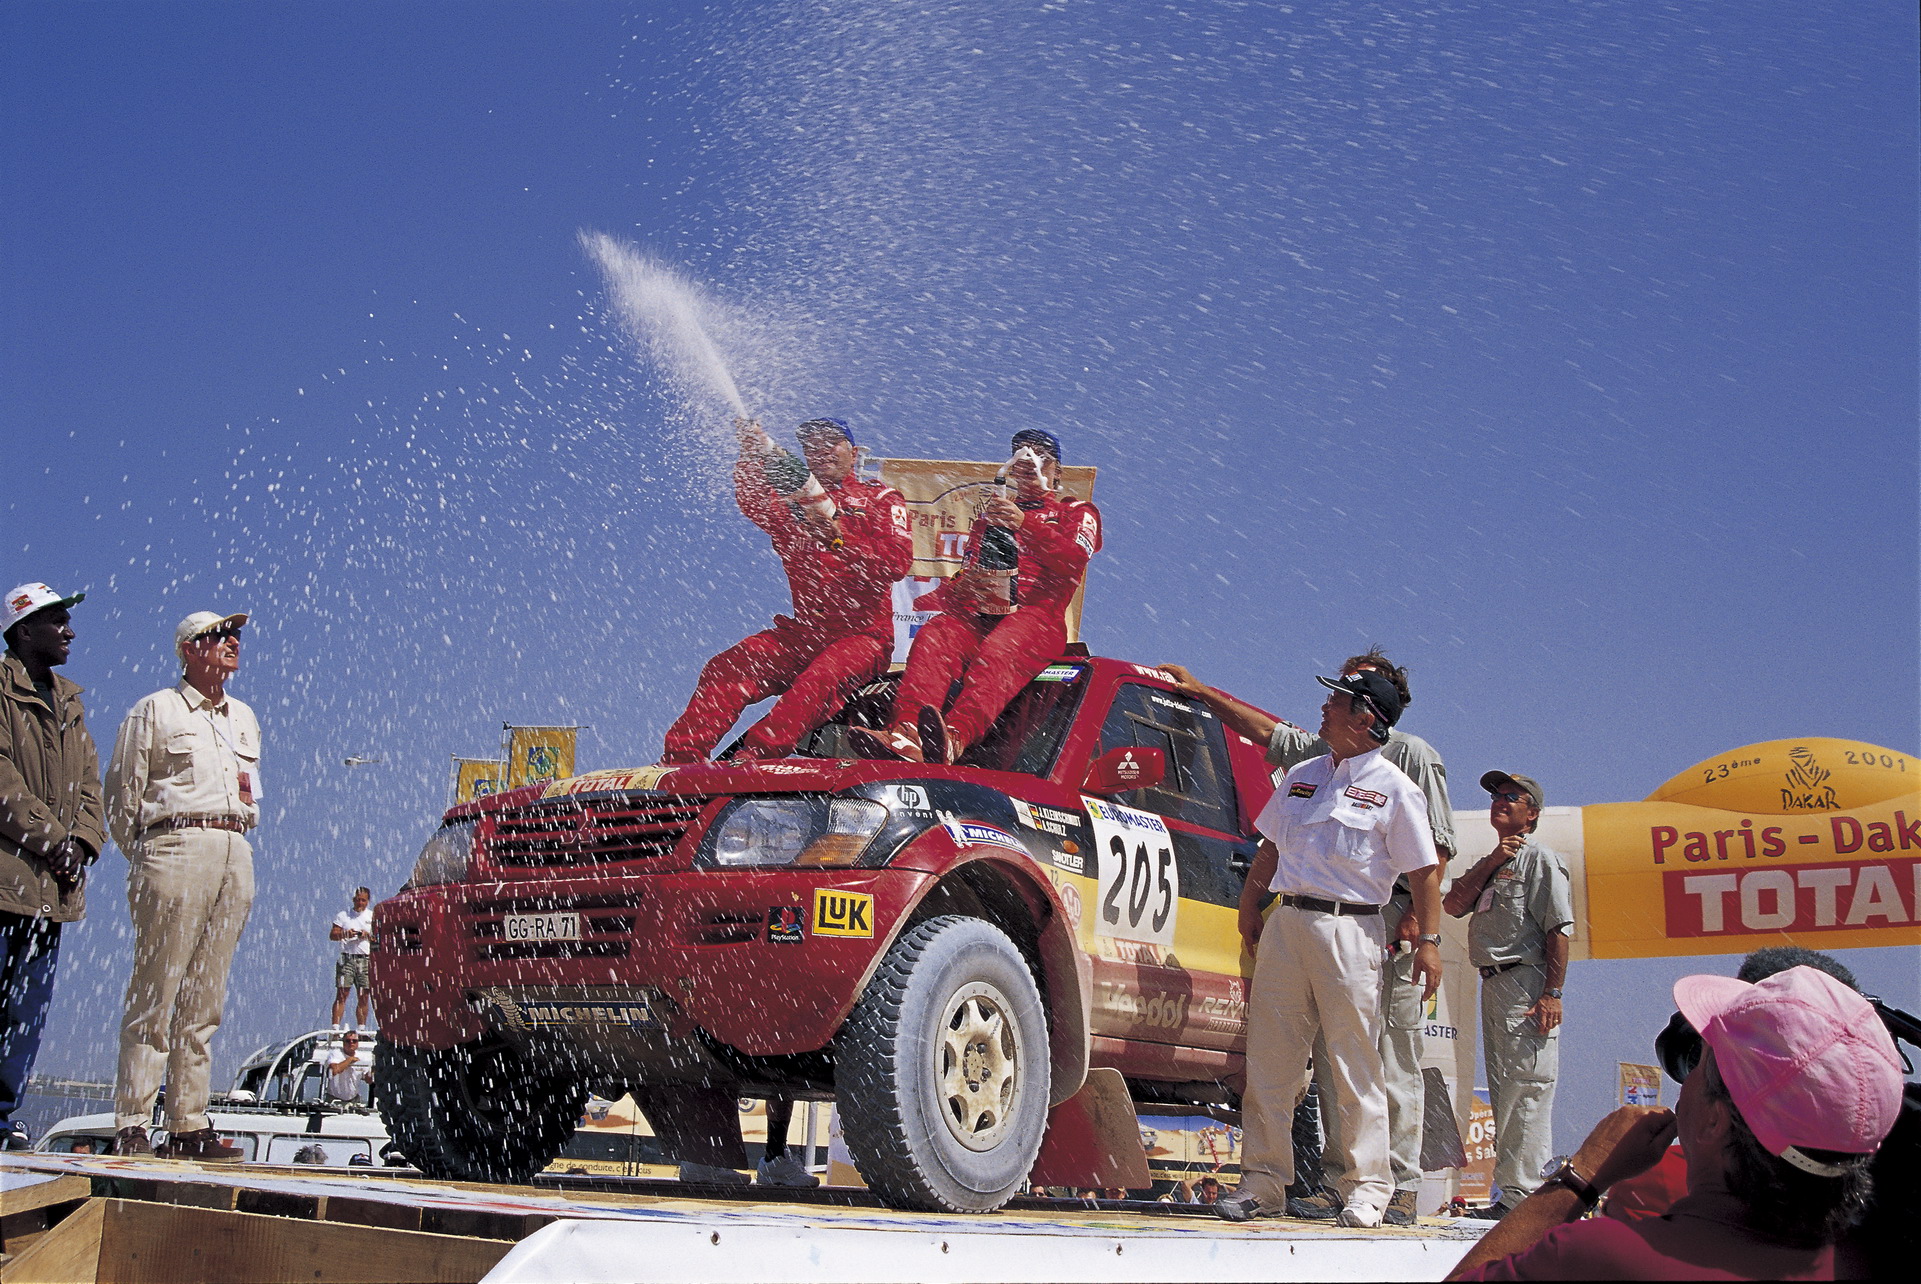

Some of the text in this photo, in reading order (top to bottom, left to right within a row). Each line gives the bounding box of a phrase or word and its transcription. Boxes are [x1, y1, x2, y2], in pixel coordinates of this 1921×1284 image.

[909, 509, 956, 529] Paris
[1703, 757, 1761, 783] 23ème
[1844, 751, 1906, 773] 2001
[572, 777, 627, 794] TOTAL
[901, 785, 917, 809] hp
[1780, 785, 1841, 810] DAKAR
[1098, 805, 1167, 834] EUROMASTER
[1651, 818, 1787, 864] Paris
[1830, 810, 1921, 854] Dak
[1102, 834, 1172, 933] 205
[1683, 863, 1921, 933] TOTA
[508, 917, 576, 938] GG-RA 71
[1115, 940, 1161, 966] TOTAL
[527, 1007, 650, 1021] MICHELIN
[1424, 1024, 1458, 1040] ASTER
